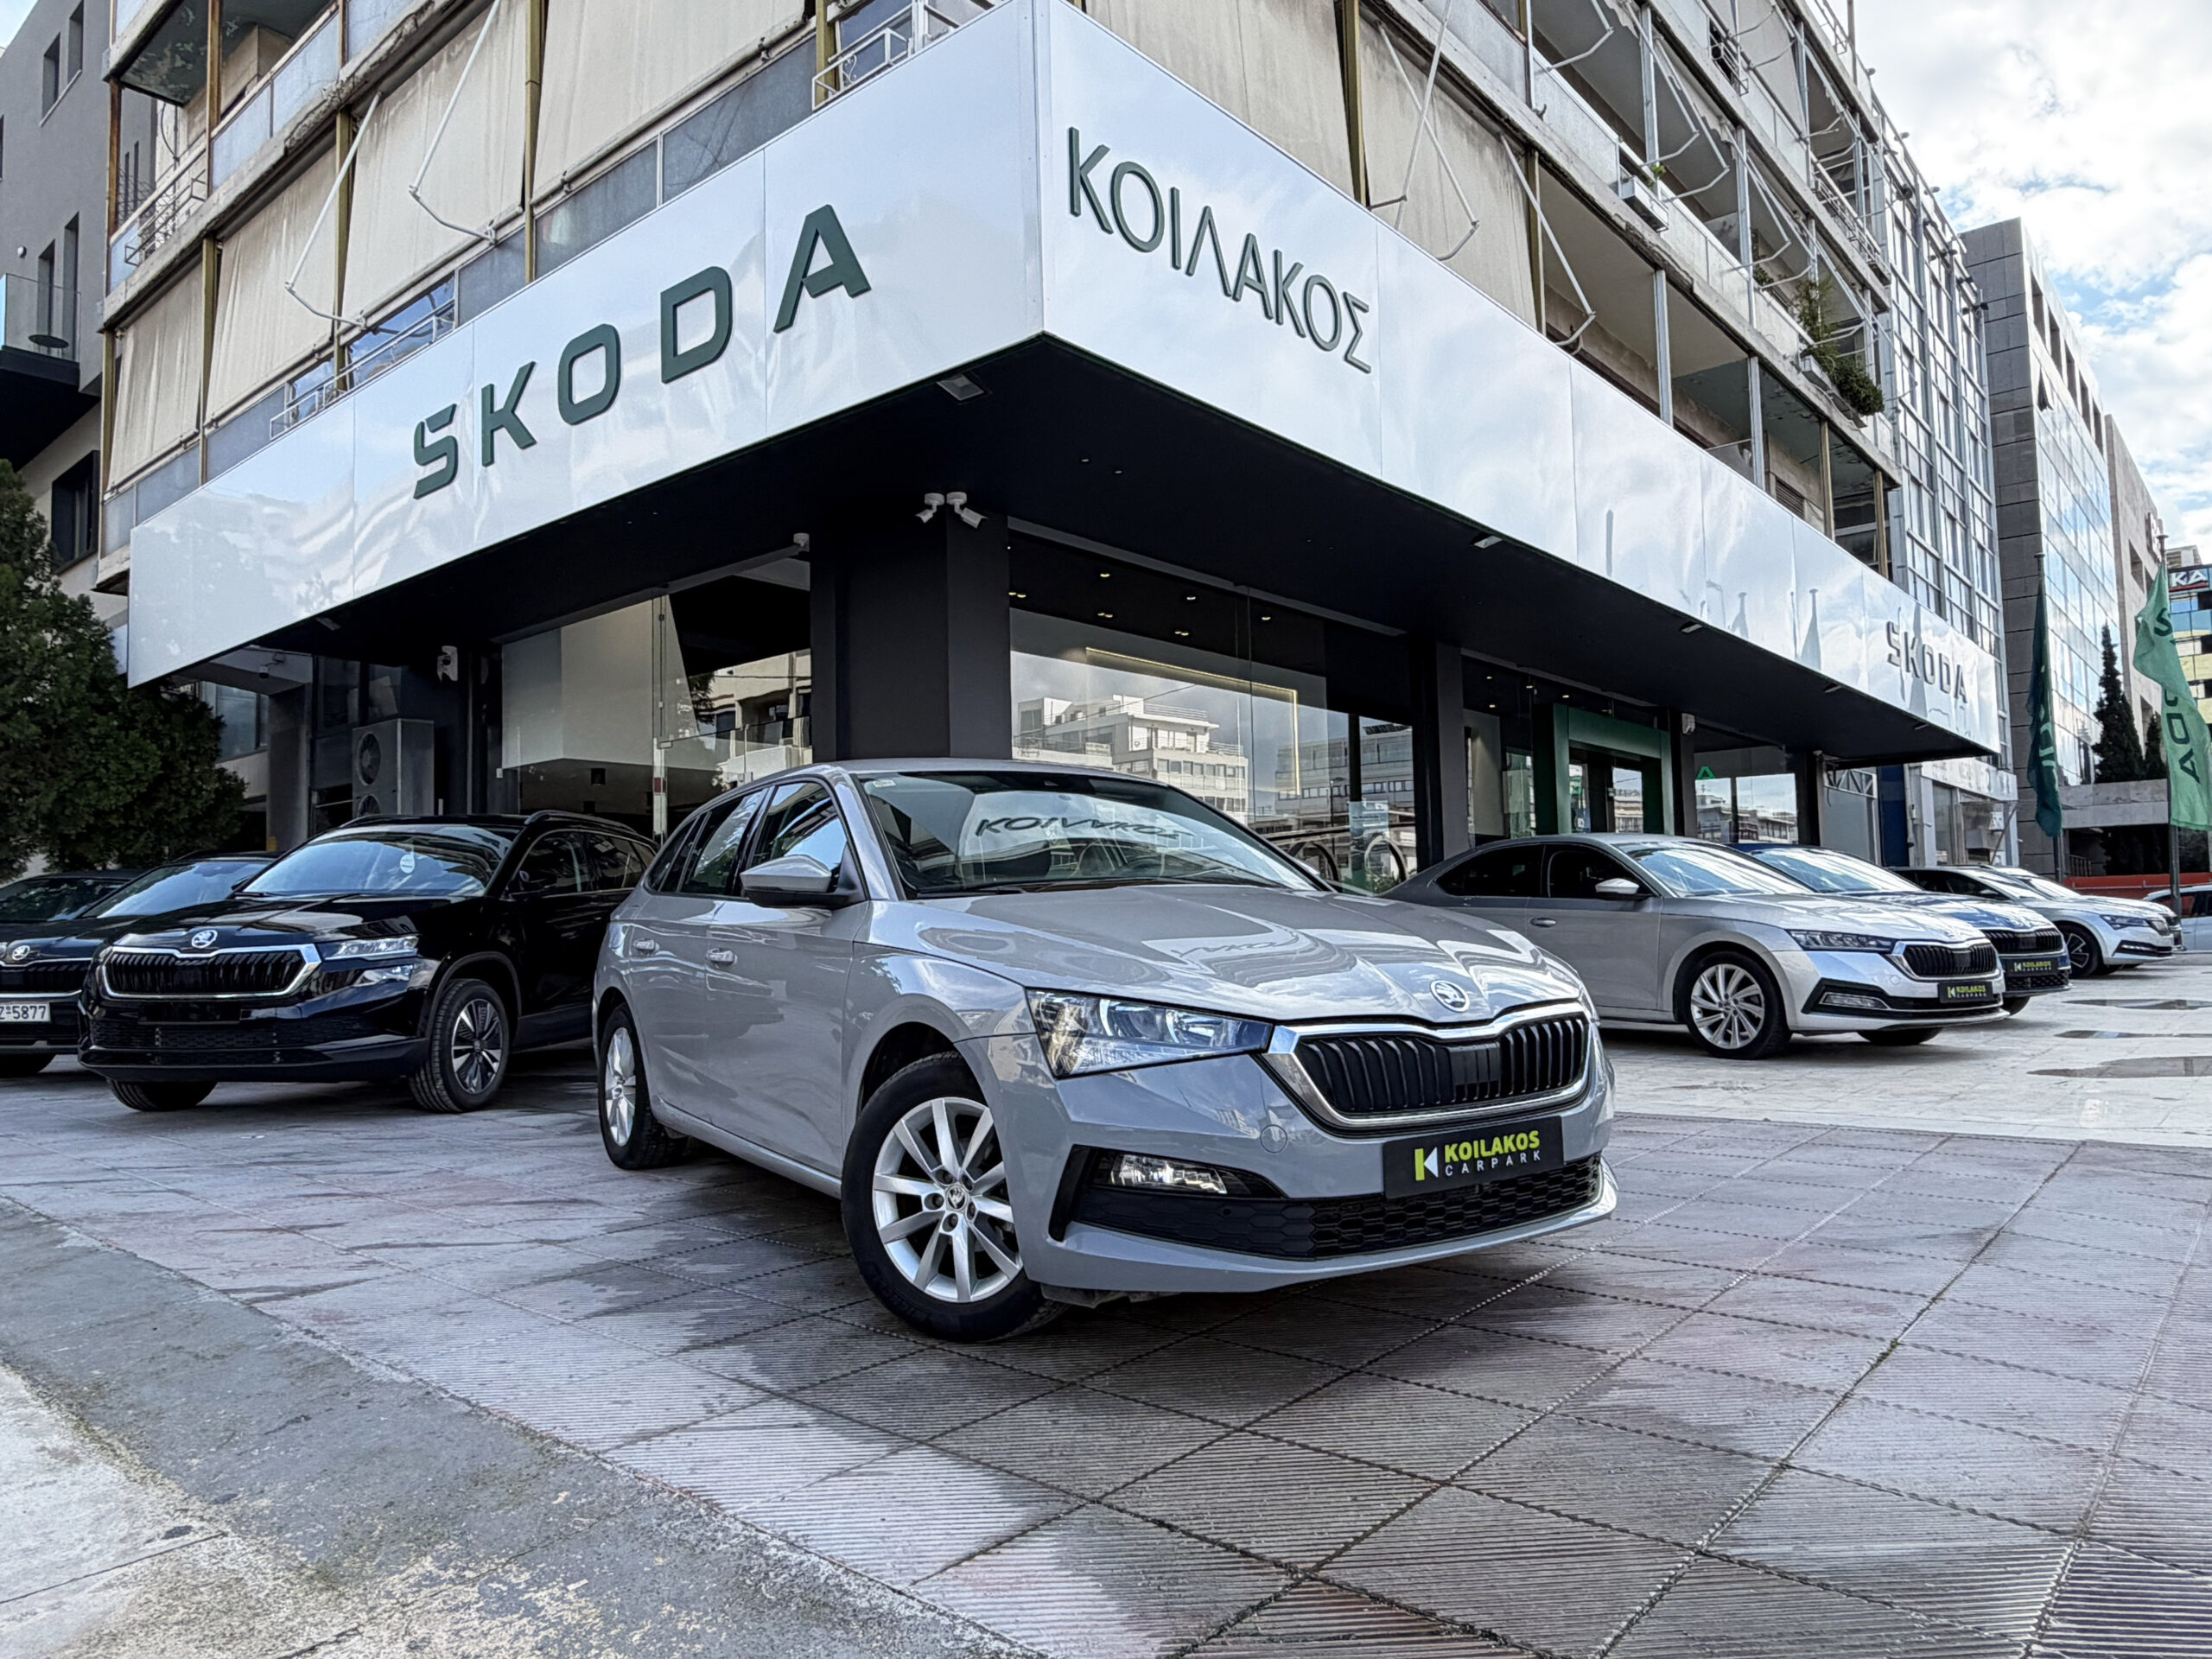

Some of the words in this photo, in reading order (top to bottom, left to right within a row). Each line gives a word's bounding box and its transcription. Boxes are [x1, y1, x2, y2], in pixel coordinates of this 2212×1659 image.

[1068, 126, 1371, 374] ΚΟΙΛΑΚΟΣ
[413, 204, 872, 500] SKODA
[1886, 620, 1967, 704] SKODA
[1444, 1130, 1541, 1163] KOILAKOS
[1445, 1149, 1541, 1177] CARPARK
